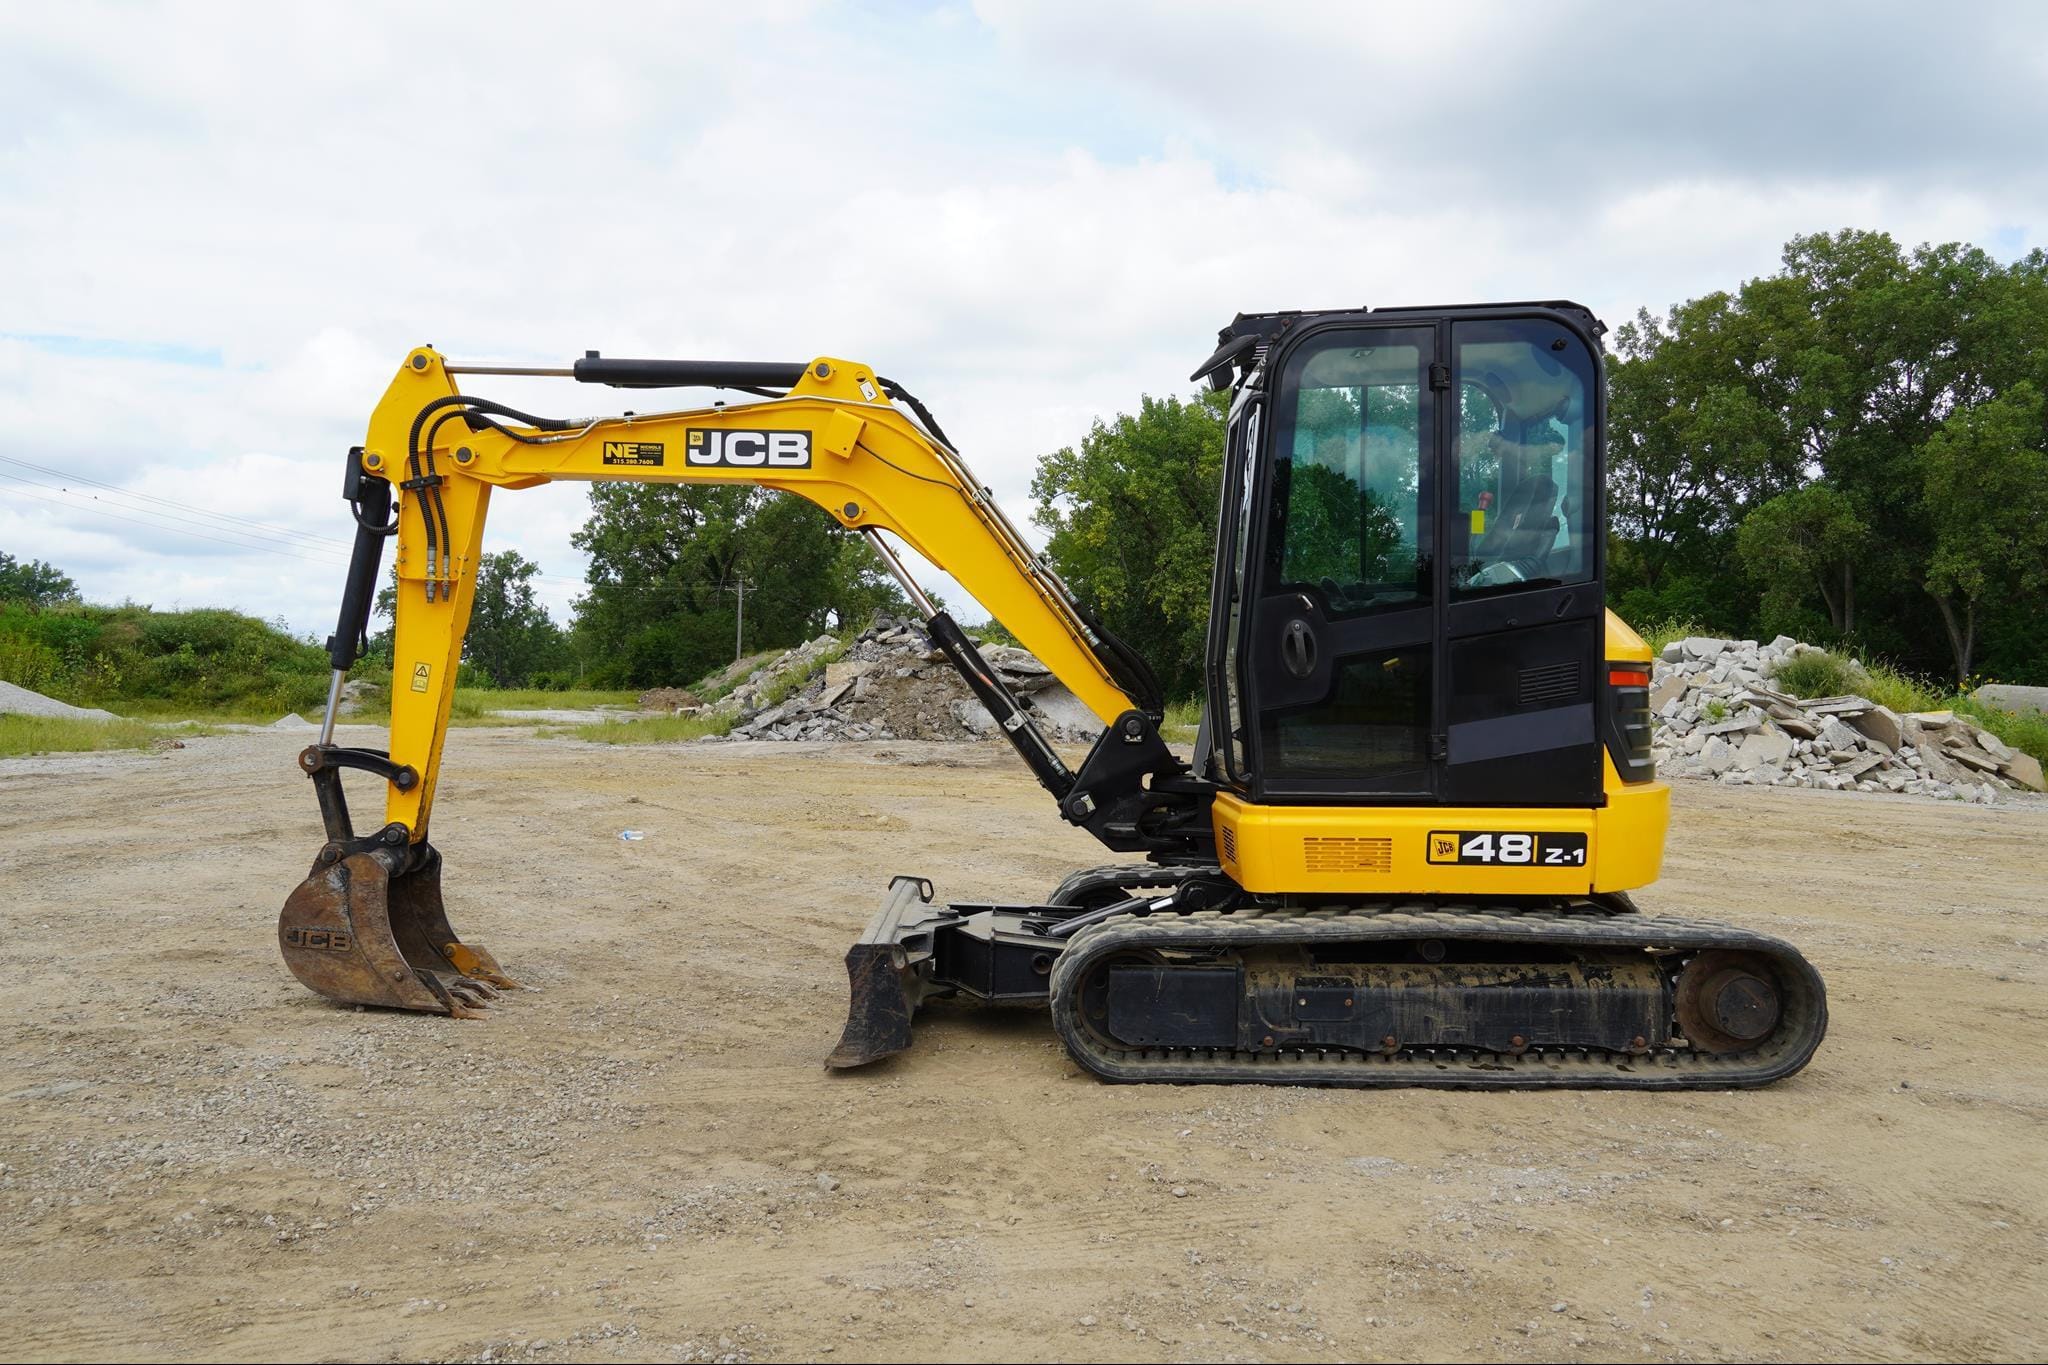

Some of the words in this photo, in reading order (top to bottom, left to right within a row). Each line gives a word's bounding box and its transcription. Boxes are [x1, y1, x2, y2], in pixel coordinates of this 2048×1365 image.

[605, 443, 639, 458] NE
[688, 431, 809, 466] JCB
[1436, 839, 1455, 855] JCB
[1462, 834, 1532, 863] 48
[1545, 848, 1585, 864] Z-1
[285, 929, 353, 951] JCB
